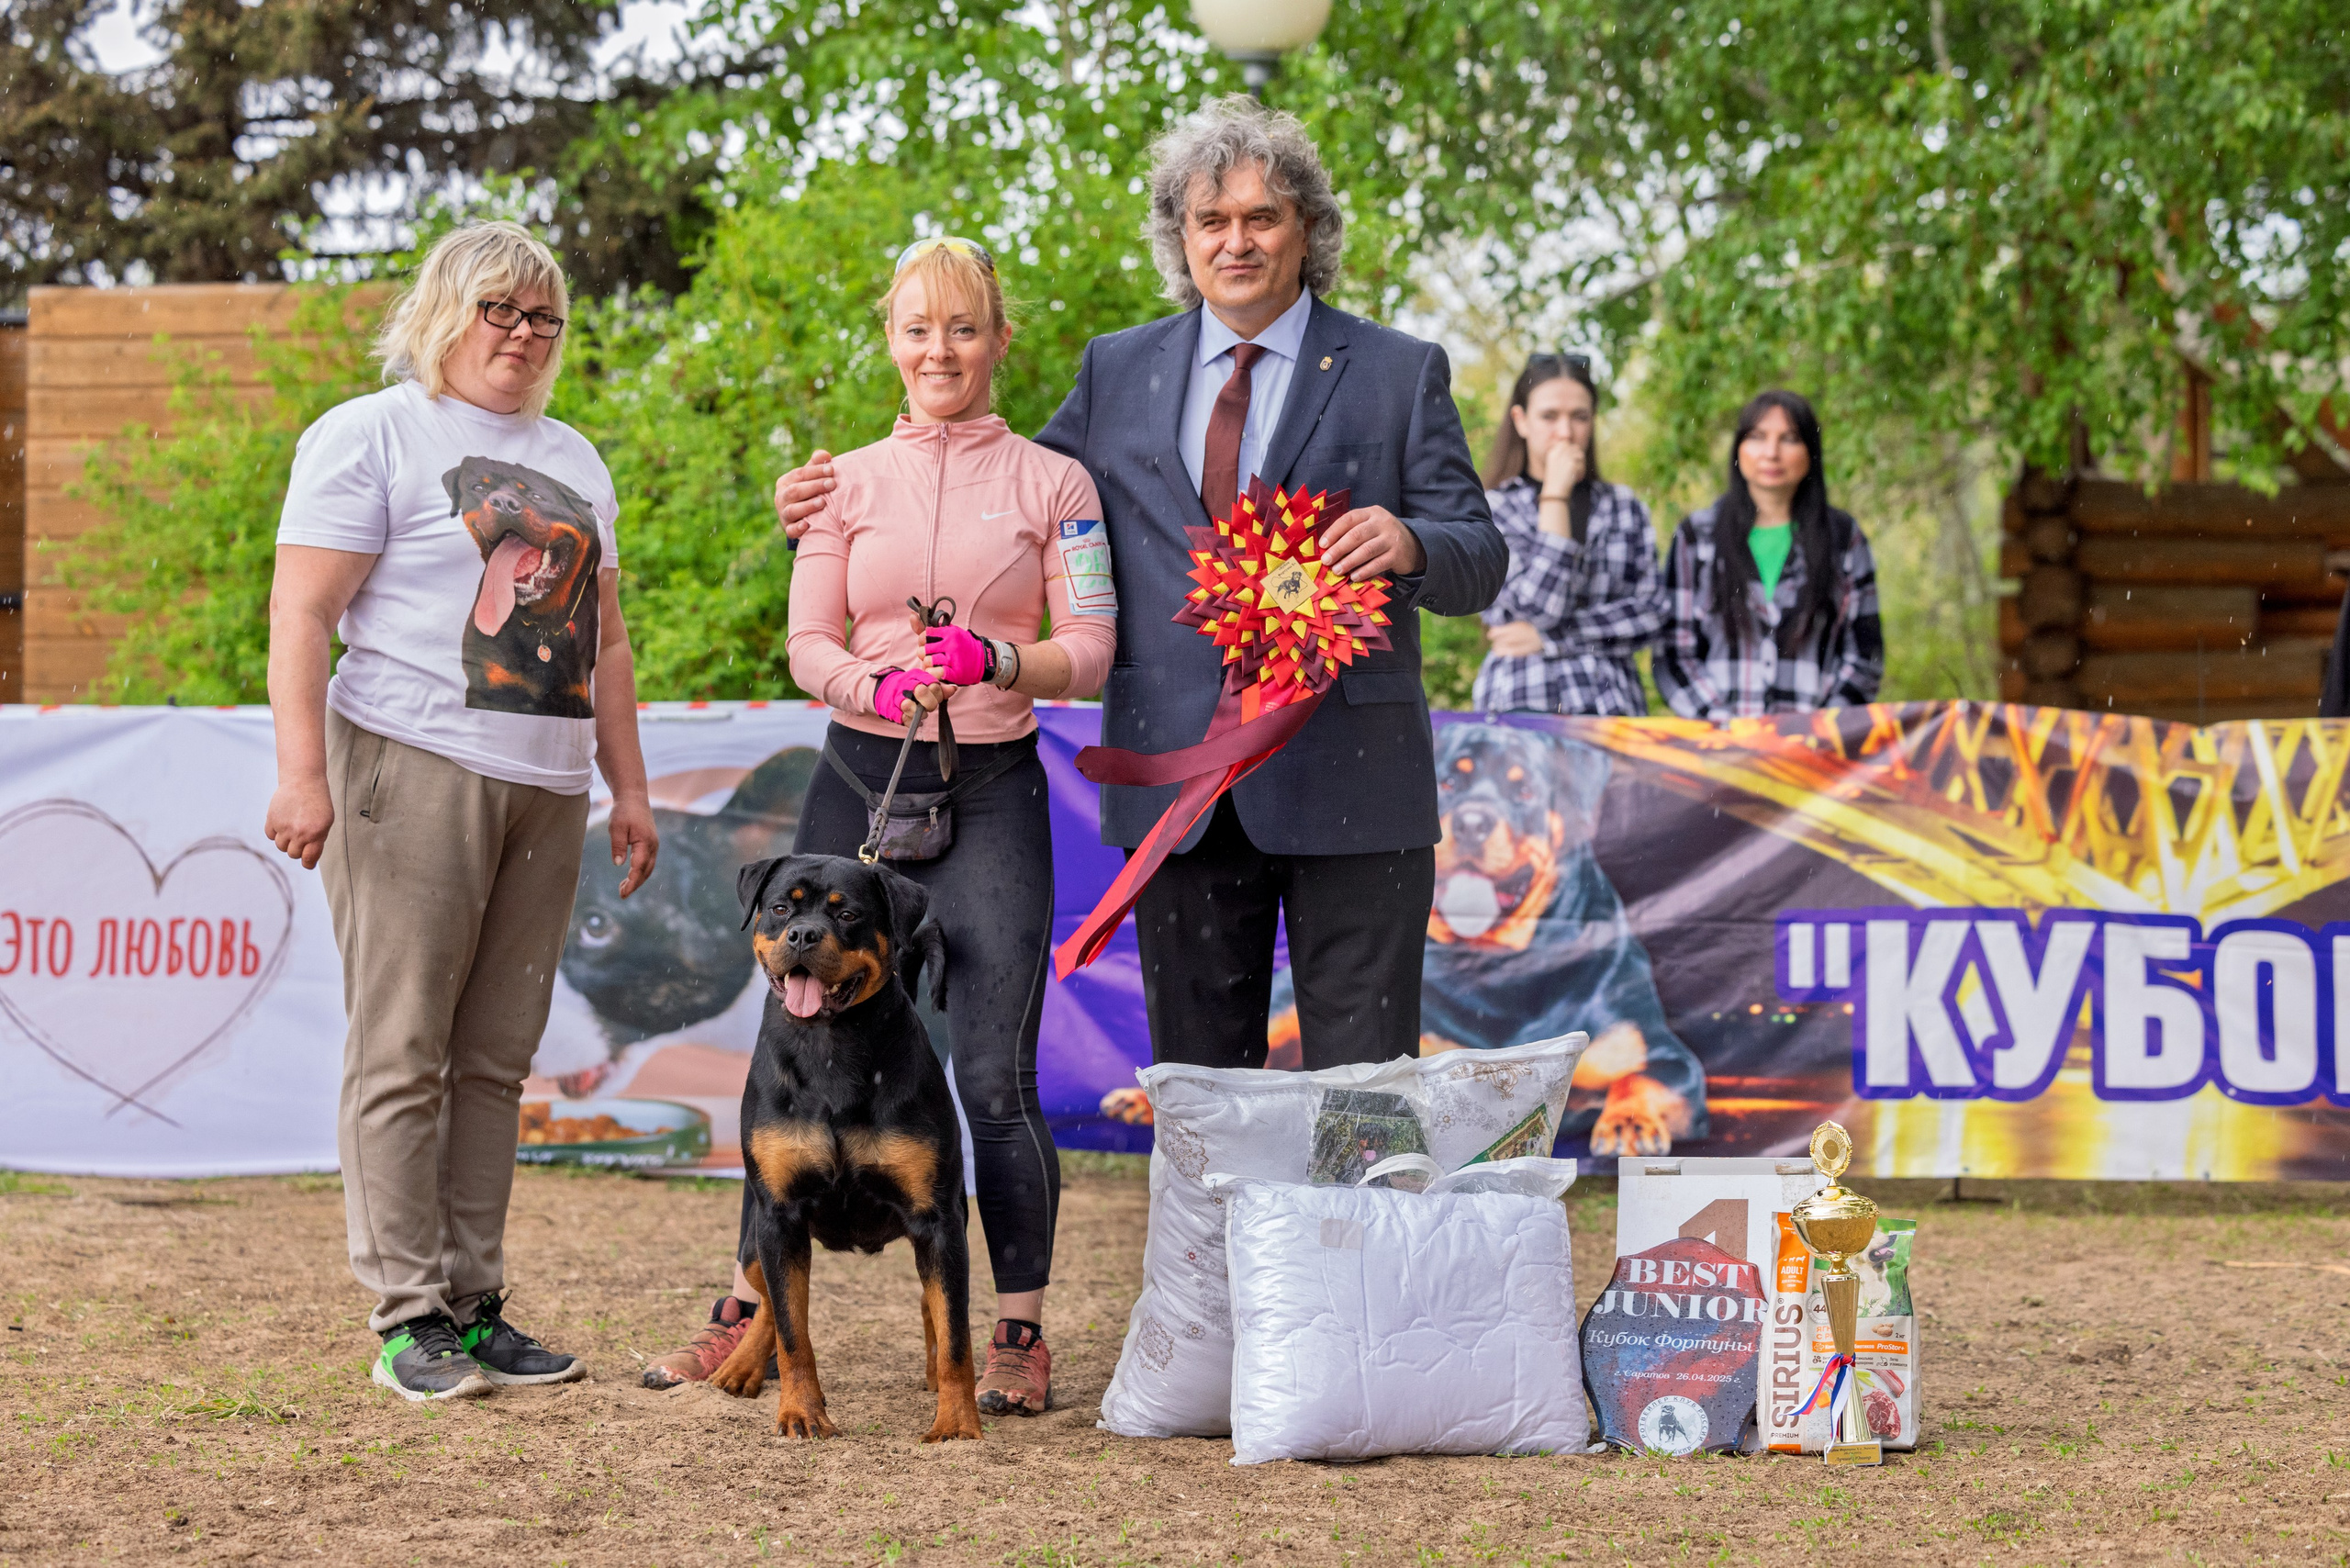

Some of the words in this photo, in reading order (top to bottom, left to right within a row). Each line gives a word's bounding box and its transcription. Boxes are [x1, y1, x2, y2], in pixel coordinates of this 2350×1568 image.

[0, 910, 73, 977] ЭТО
[89, 917, 261, 978] ЛЮБОВЬ
[1625, 1258, 1749, 1290] BEST
[1781, 1266, 1804, 1275] ADULT
[1592, 1290, 1769, 1323] JUNIOR
[1588, 1329, 1651, 1348] Кубок
[1654, 1333, 1753, 1354] Фортуны
[1876, 1342, 1905, 1351] ProStor+
[1624, 1369, 1670, 1380] Саратов
[1675, 1372, 1732, 1383] 26.04.2025
[1771, 1304, 1804, 1428] SIRIUS
[1673, 1396, 1697, 1408] КЛУБ
